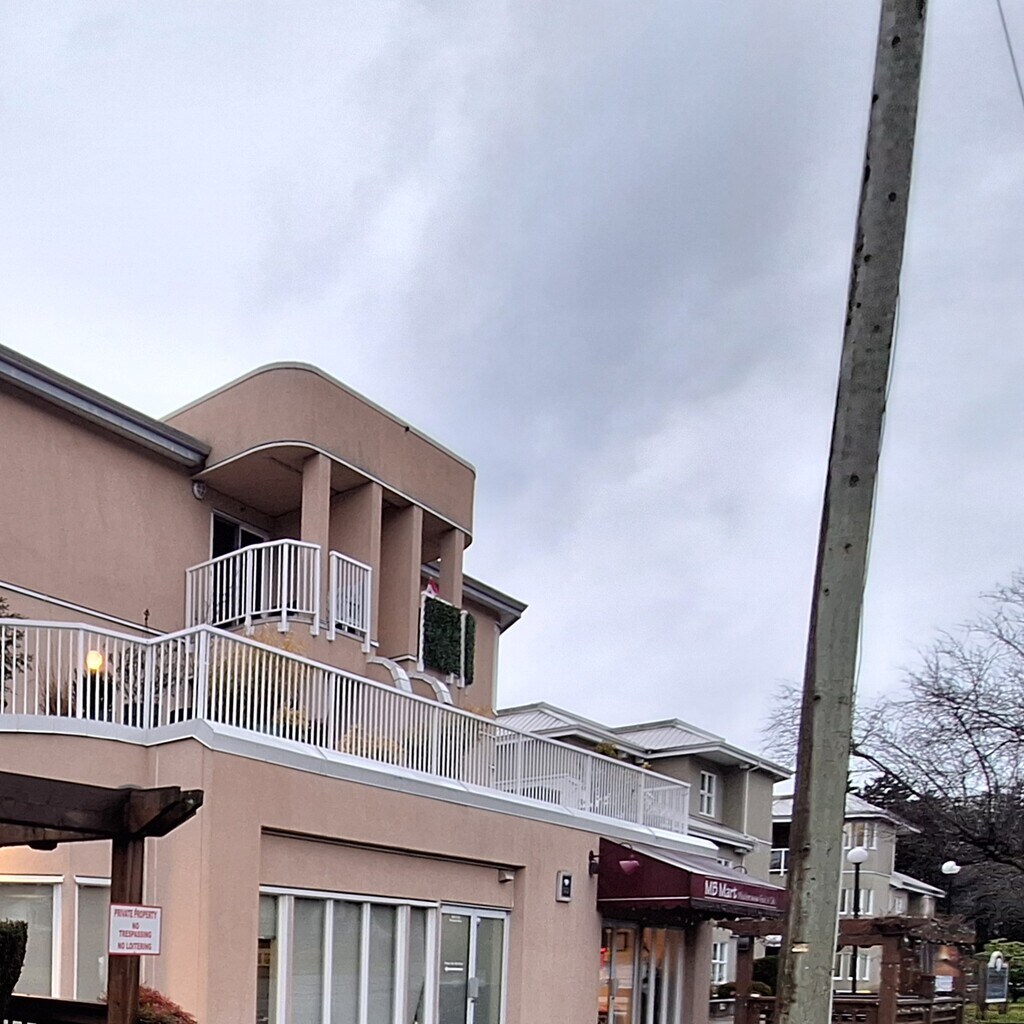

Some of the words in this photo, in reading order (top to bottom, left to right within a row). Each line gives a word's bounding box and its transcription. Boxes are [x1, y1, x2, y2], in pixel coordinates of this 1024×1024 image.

[718, 882, 737, 899] Mart
[114, 908, 133, 918] PRIVATE
[134, 909, 157, 919] PROPERTY
[132, 922, 140, 930] NO
[118, 930, 152, 938] TRESPASSING
[117, 942, 125, 950] NO
[125, 942, 152, 950] LOITERING
